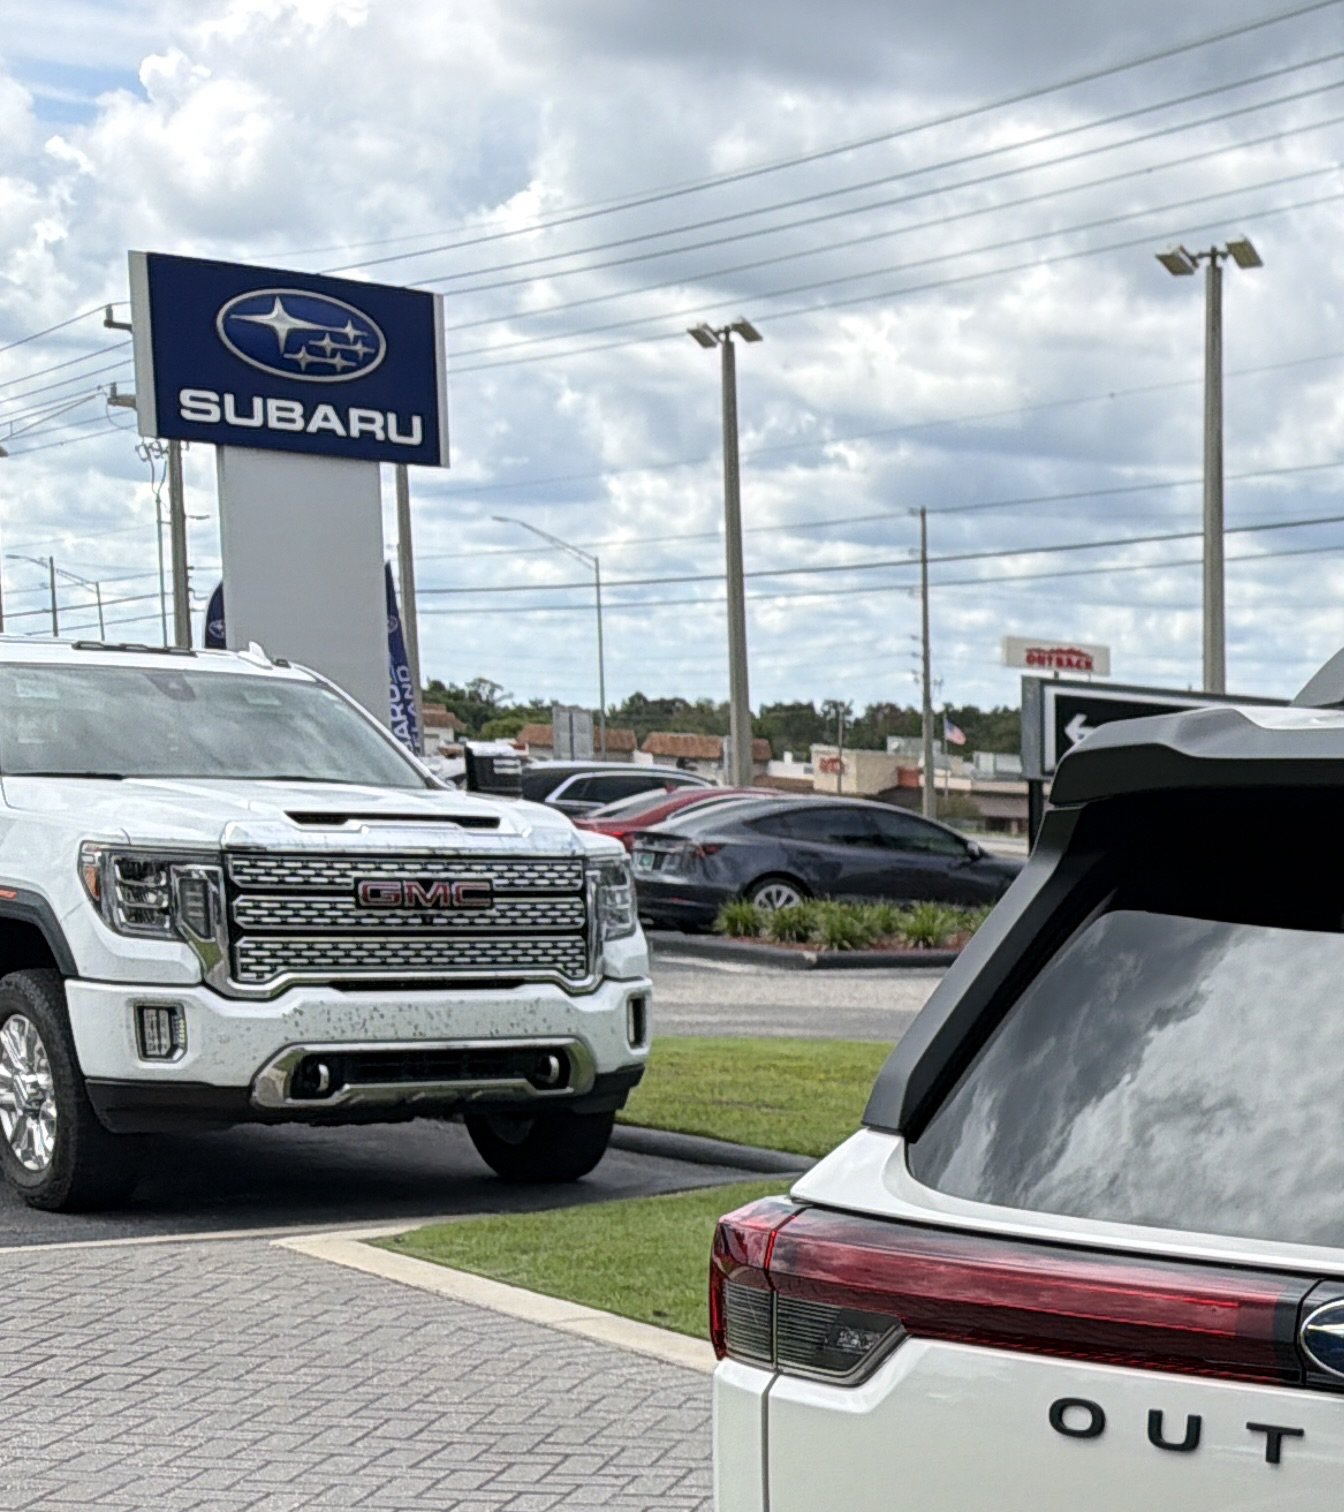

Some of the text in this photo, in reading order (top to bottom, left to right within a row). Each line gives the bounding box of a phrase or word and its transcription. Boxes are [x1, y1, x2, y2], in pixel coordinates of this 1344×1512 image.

[179, 388, 423, 446] SUBARU
[1025, 652, 1093, 671] OUTBACK
[358, 880, 492, 908] GMC
